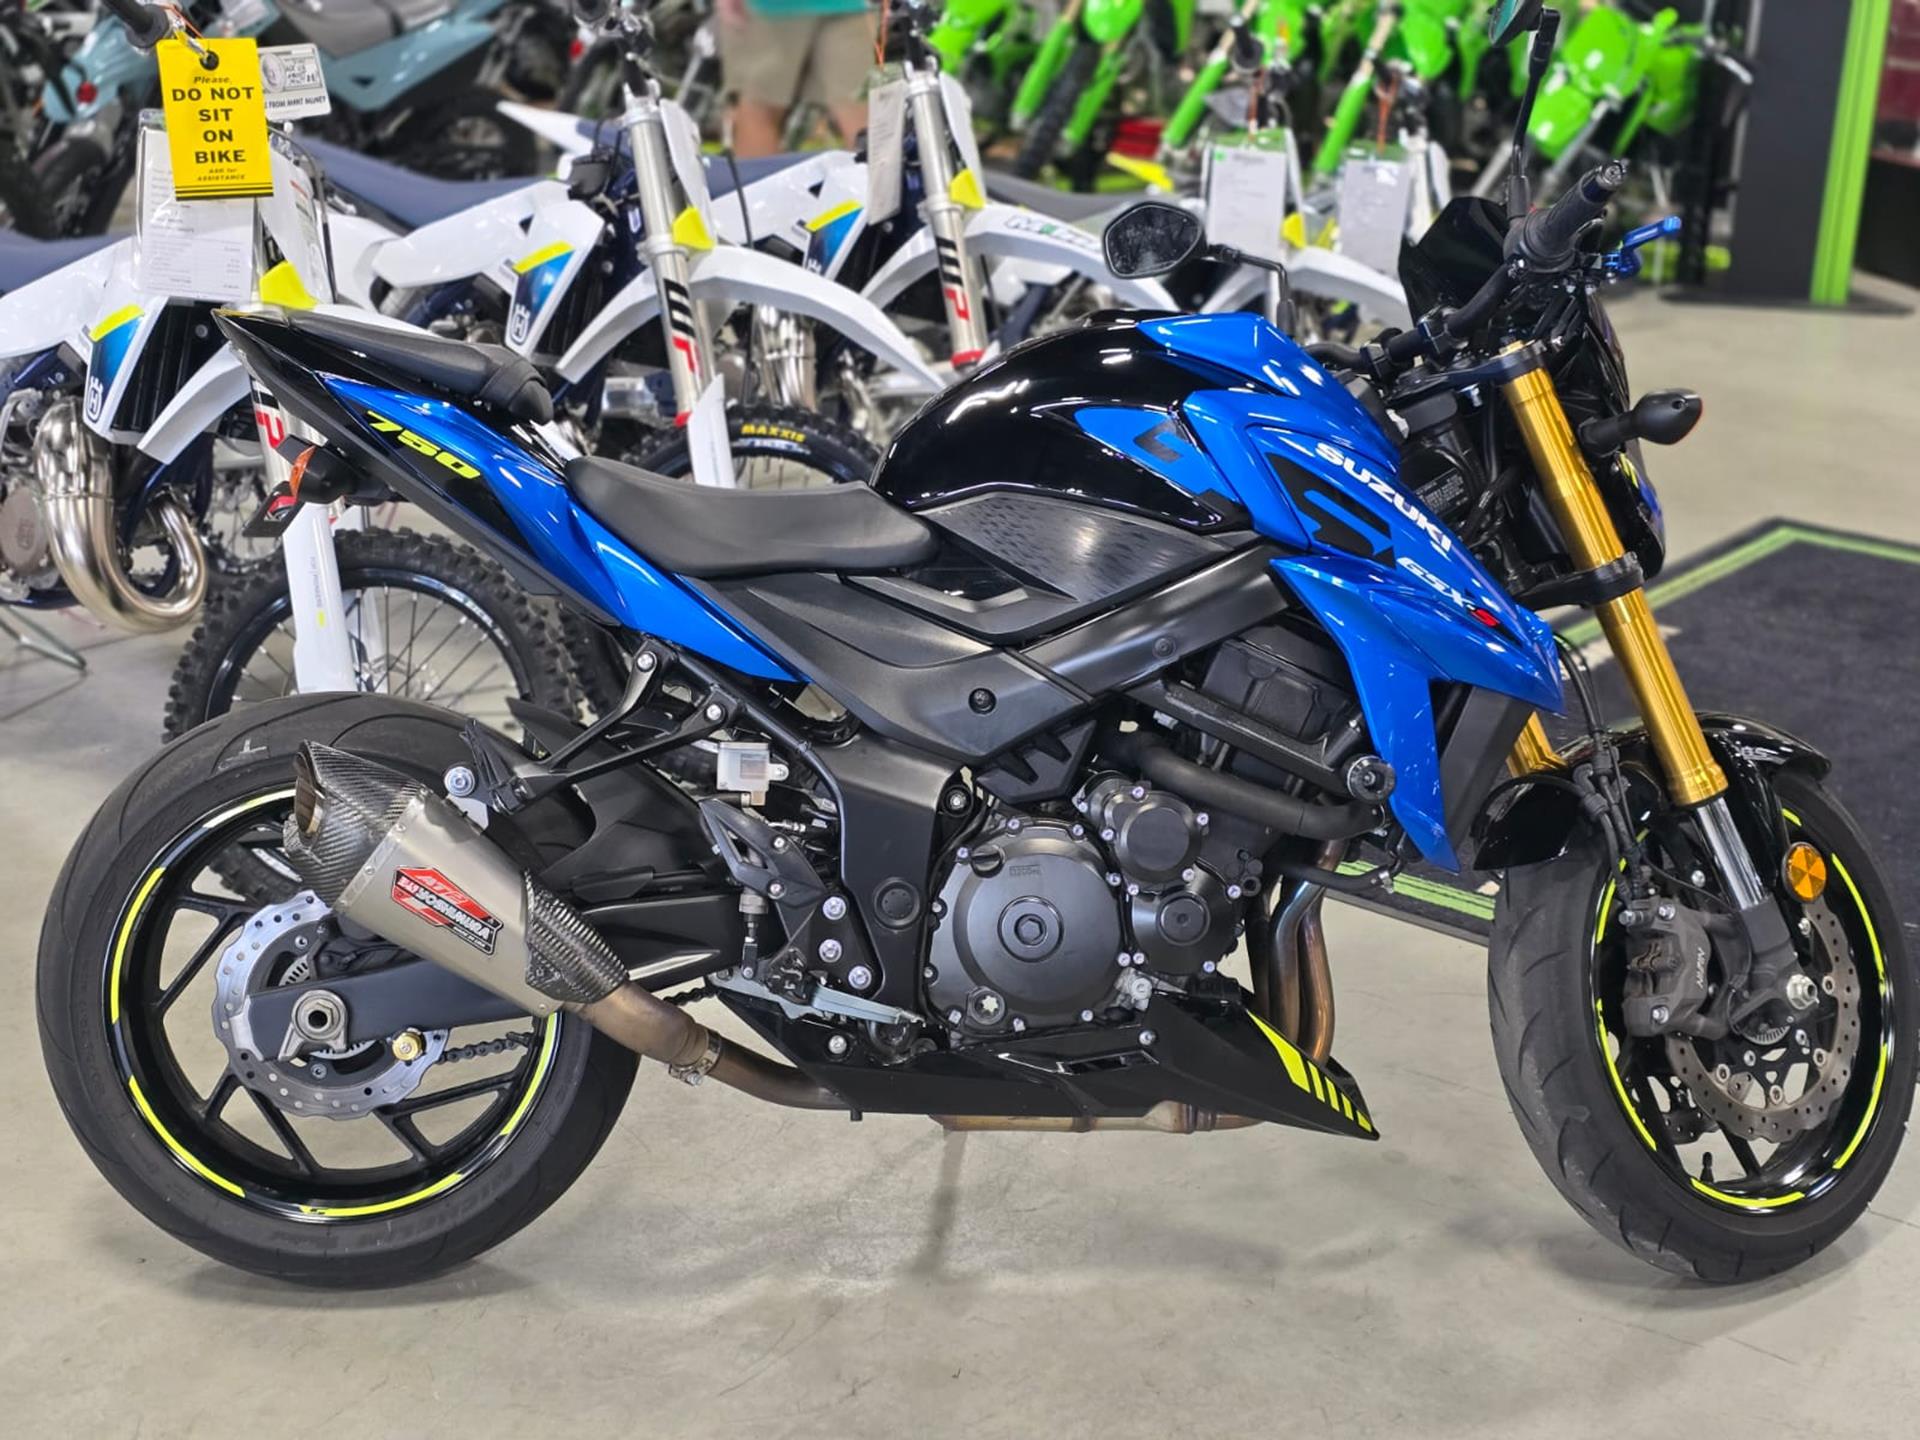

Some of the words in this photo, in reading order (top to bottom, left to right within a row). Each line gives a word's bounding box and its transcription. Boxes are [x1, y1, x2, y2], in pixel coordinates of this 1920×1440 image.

[172, 88, 202, 102] DO
[210, 86, 254, 101] NOT
[198, 108, 233, 122] SIT
[203, 129, 234, 143] ON
[194, 149, 246, 164] BIKE
[740, 422, 806, 443] MAXXIS
[366, 409, 481, 480] 750
[1314, 441, 1452, 553] SUZUKI
[1396, 556, 1501, 628] GSX-S
[414, 887, 492, 941] YOSHIMURA
